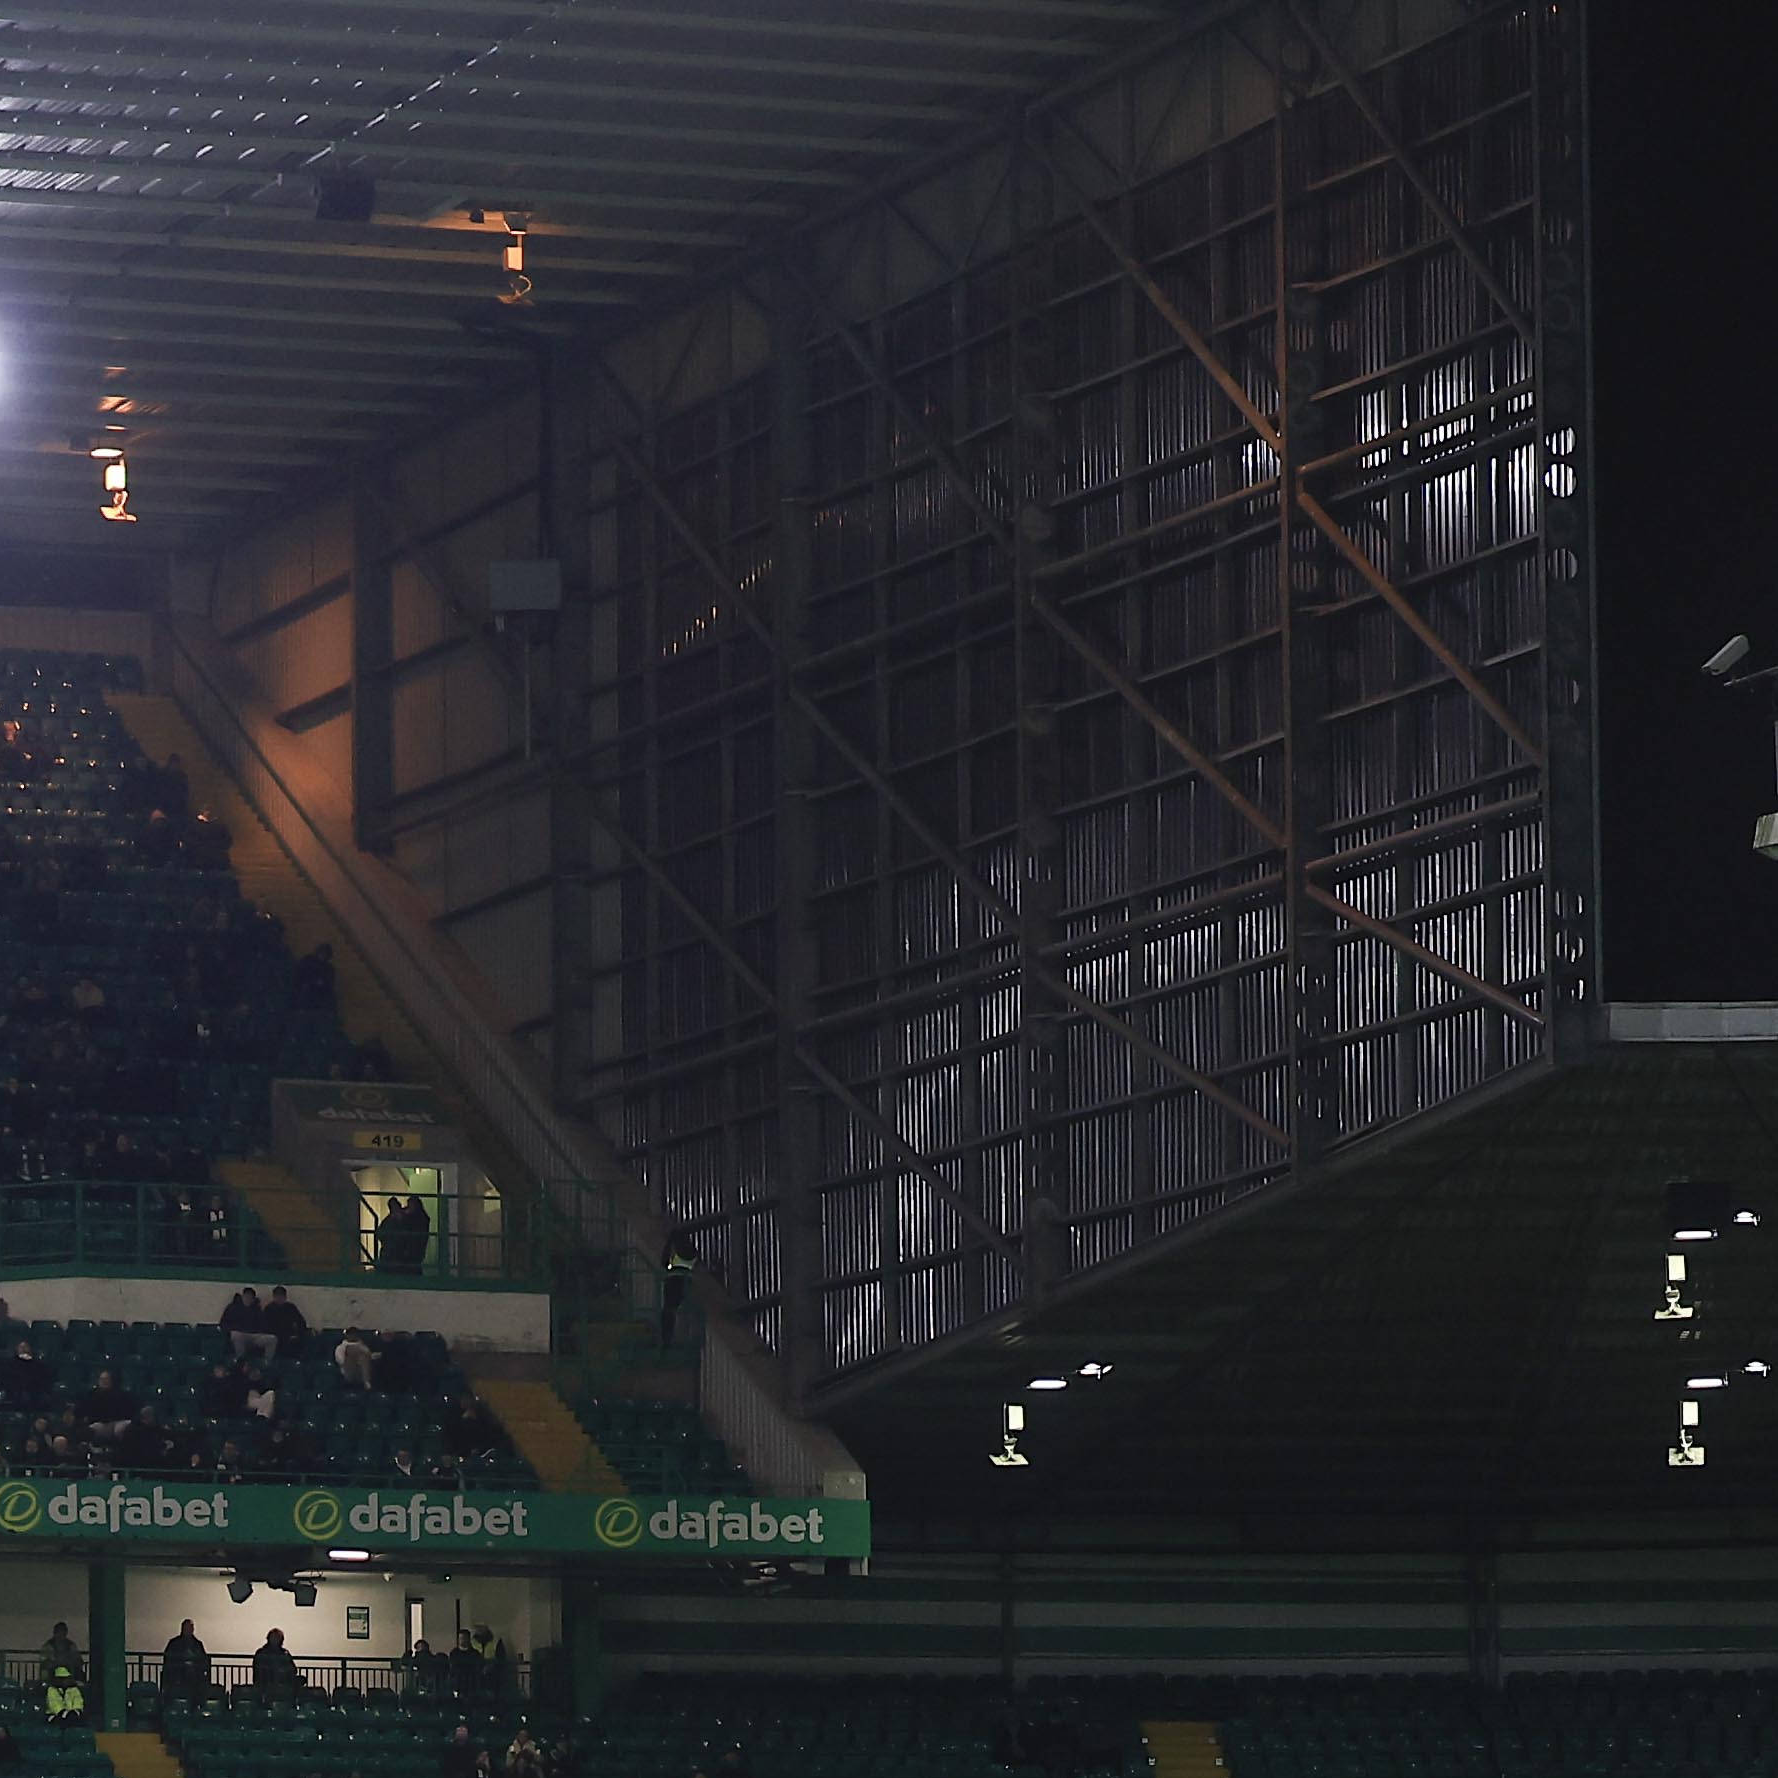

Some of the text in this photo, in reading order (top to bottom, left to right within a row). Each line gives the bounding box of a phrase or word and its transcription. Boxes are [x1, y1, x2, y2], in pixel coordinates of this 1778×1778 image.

[371, 1133, 405, 1148] 419
[48, 1483, 230, 1533] dafabet
[349, 1491, 529, 1541] dafabet
[649, 1498, 825, 1550] dafabet
